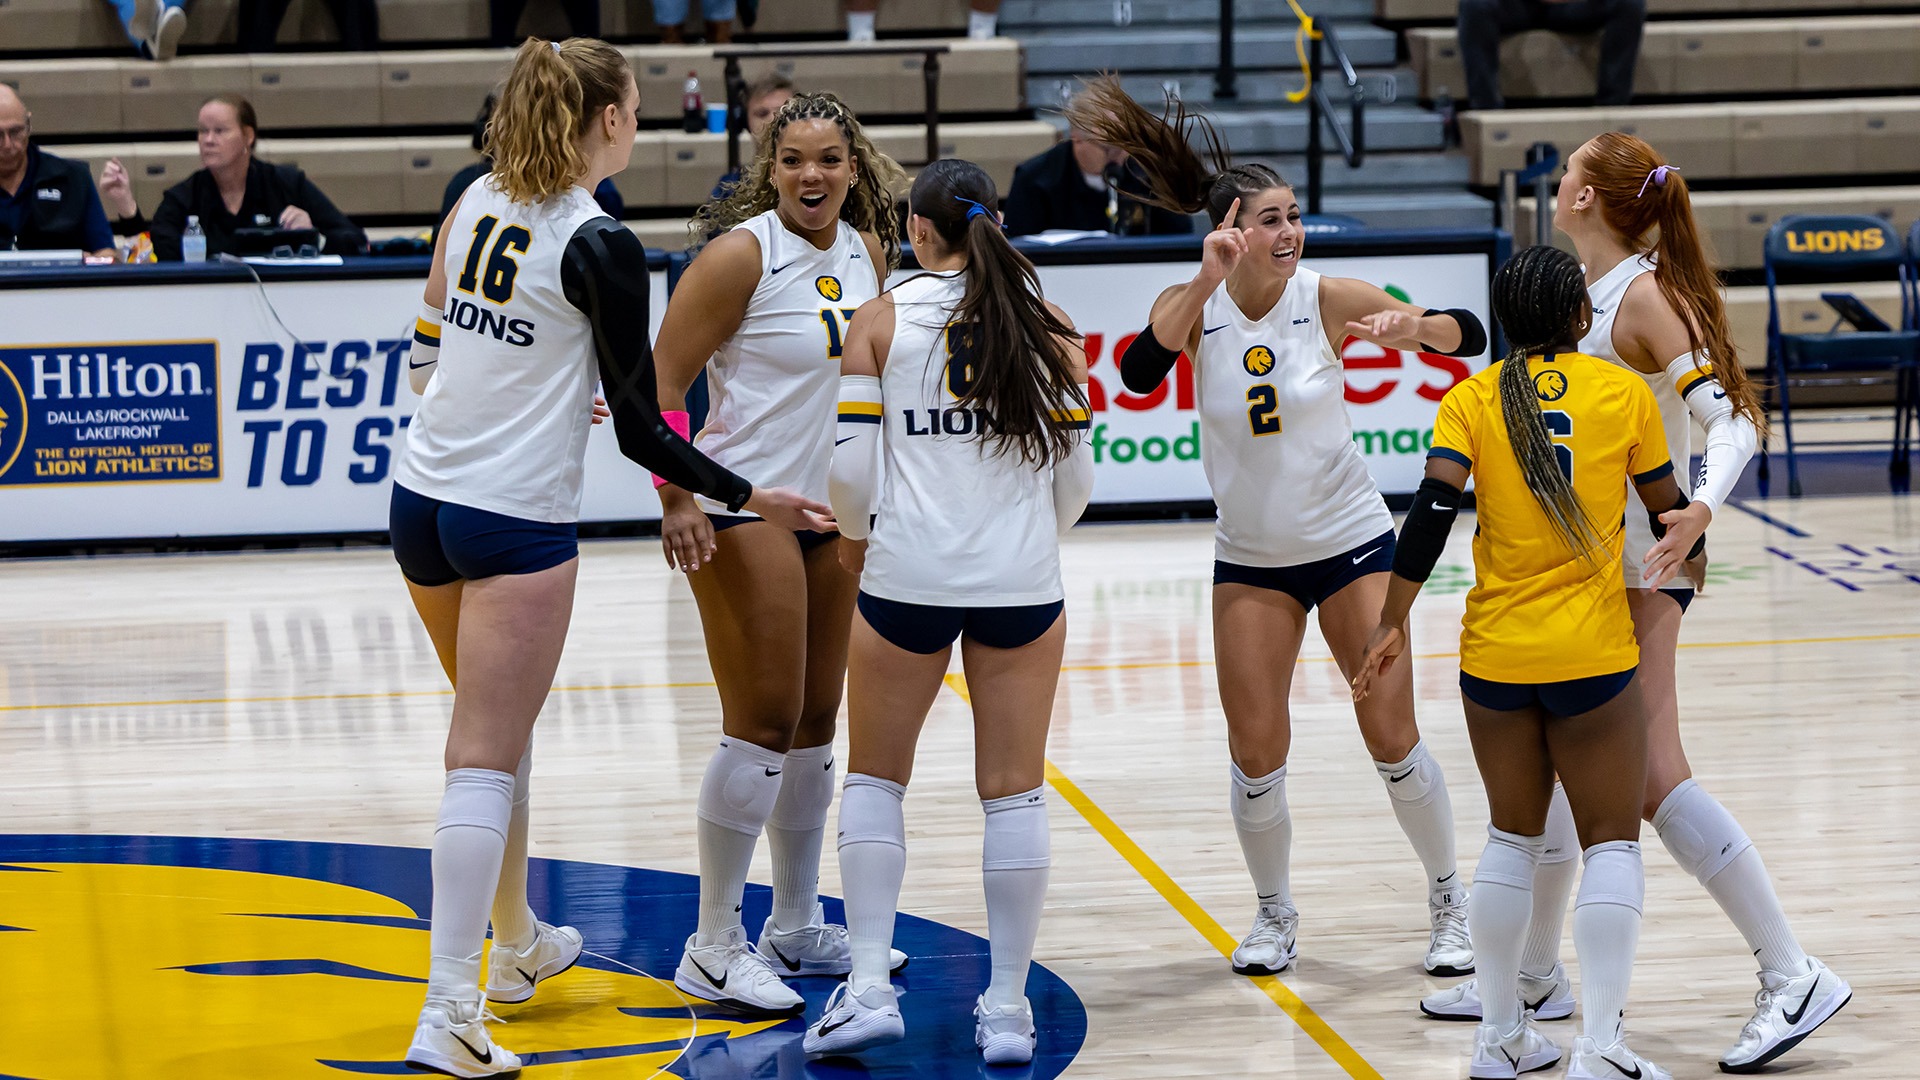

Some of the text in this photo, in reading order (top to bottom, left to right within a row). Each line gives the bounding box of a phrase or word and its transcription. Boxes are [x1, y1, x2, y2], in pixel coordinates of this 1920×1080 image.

[1785, 228, 1885, 254] LIONS
[457, 213, 533, 306] 16
[31, 353, 204, 400] Hilton
[237, 340, 412, 411] BEST
[47, 408, 190, 425] DALLAS/ROCKWALL
[903, 407, 1028, 436] LION
[1246, 383, 1283, 437] 2
[76, 425, 162, 441] LAKEFRONT
[35, 443, 212, 459] THE OFFICIAL HOTEL OF
[243, 419, 328, 488] TO
[34, 456, 214, 476] LION ATHLETICS
